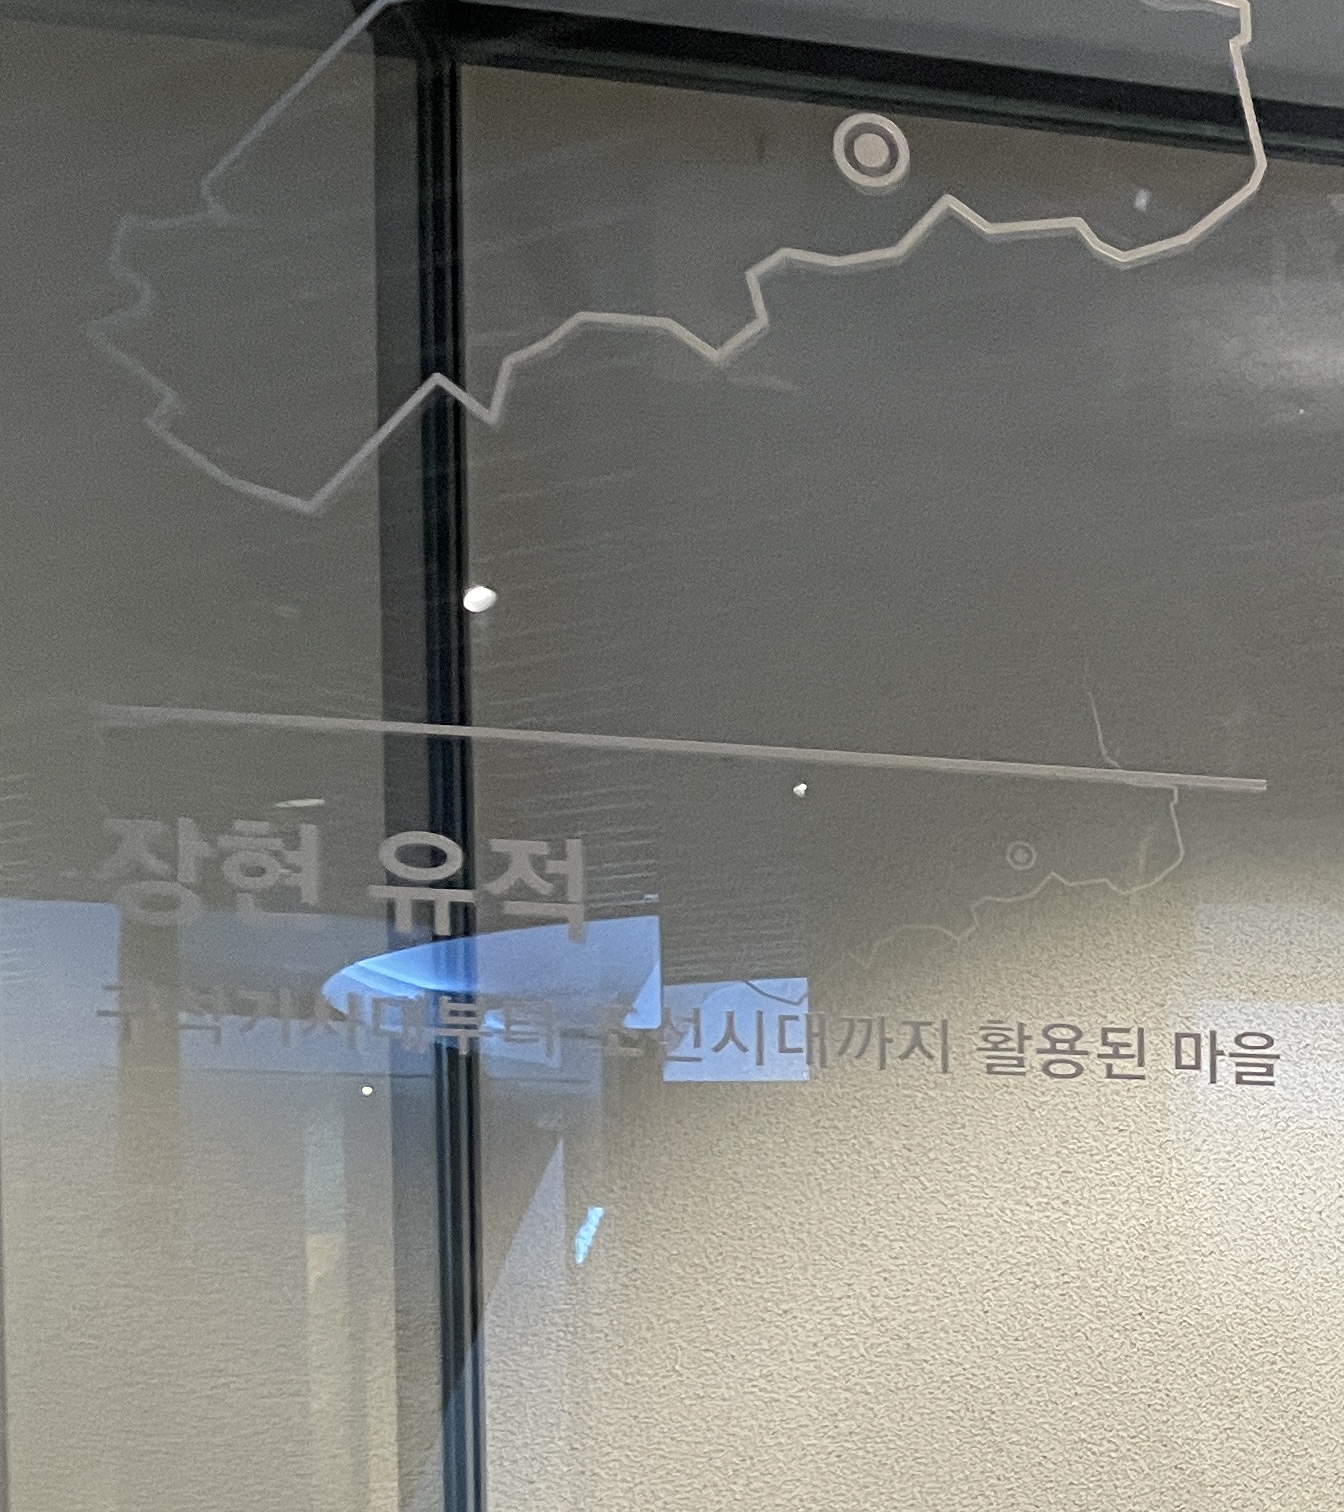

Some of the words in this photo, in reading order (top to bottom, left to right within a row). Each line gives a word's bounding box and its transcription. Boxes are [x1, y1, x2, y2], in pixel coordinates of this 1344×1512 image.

[103, 817, 319, 925] 장현
[367, 829, 588, 944] 유적
[976, 1018, 1146, 1080] 활용된
[1174, 1028, 1282, 1087] 마을
